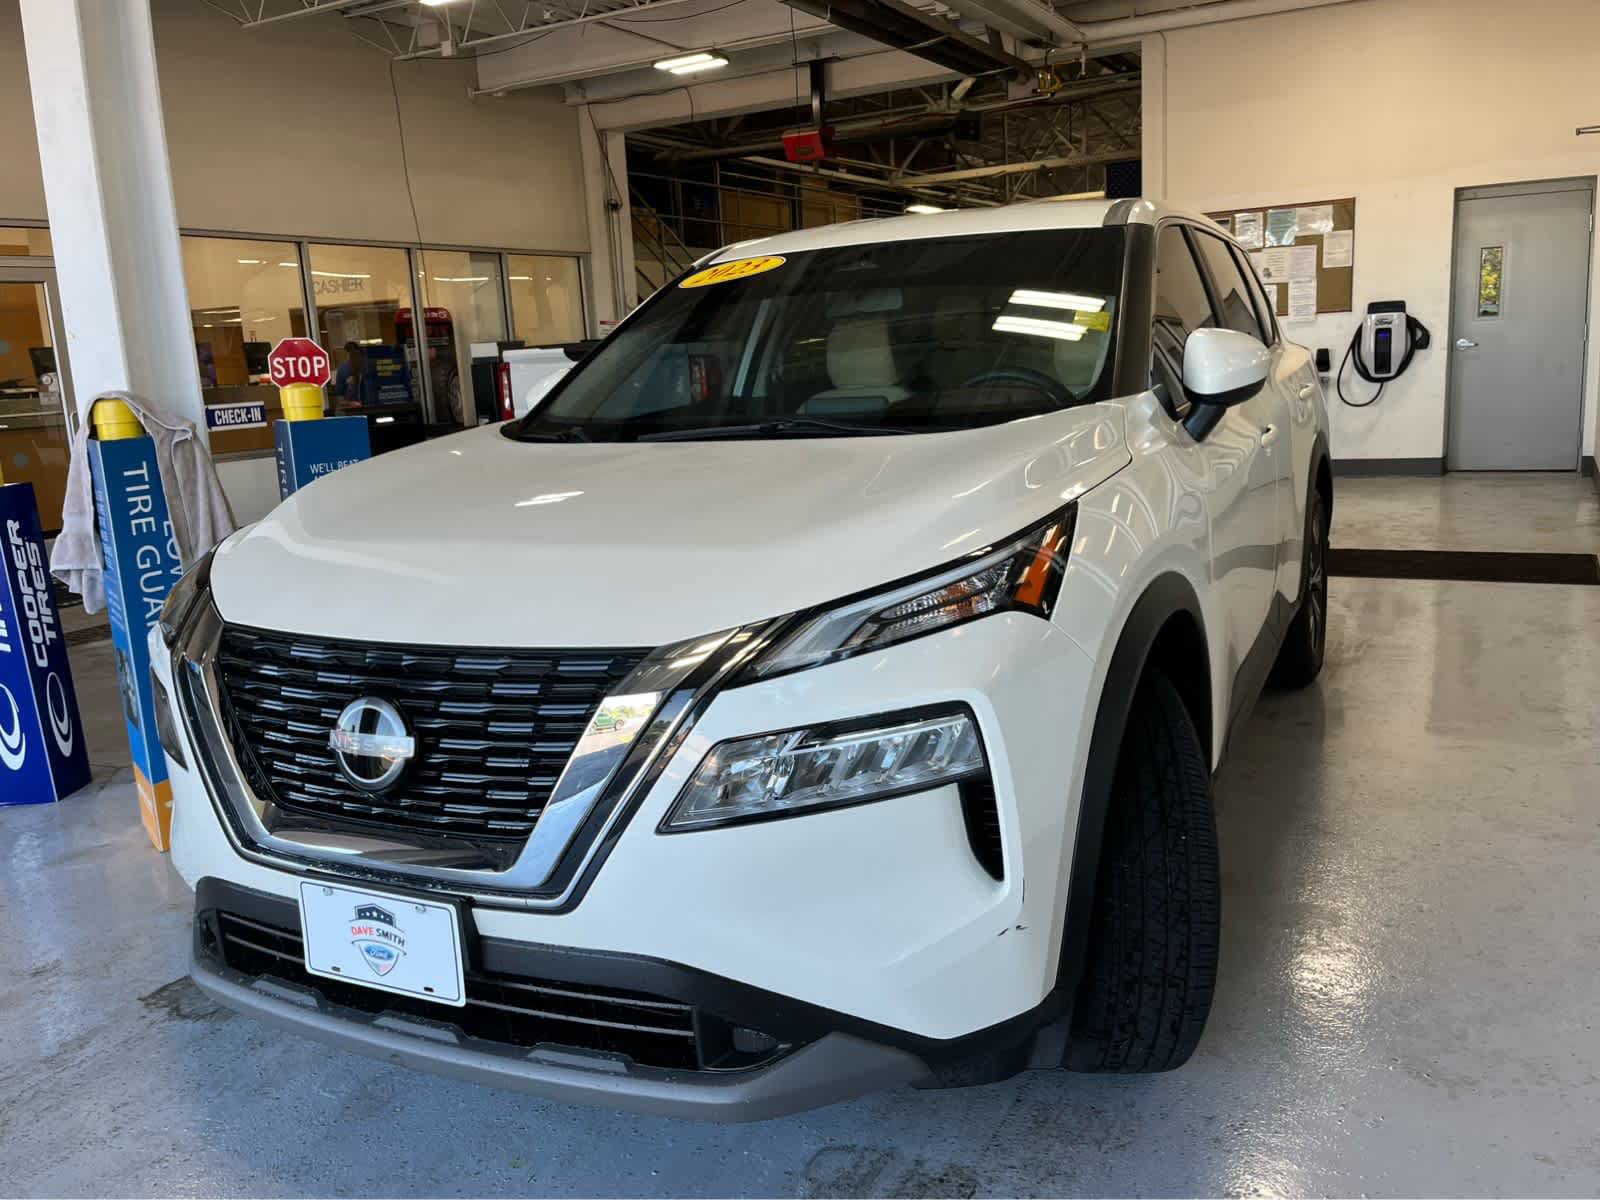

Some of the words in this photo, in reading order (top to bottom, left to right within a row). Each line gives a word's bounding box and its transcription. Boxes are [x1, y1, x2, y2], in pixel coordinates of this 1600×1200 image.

[313, 279, 366, 295] CASHIER
[272, 355, 326, 379] STOP
[214, 406, 262, 425] CHECK-IN
[310, 460, 335, 475] WE'LL
[122, 460, 157, 536] TIRE
[7, 519, 48, 668] COOPER
[26, 541, 57, 645] TIRES
[135, 544, 166, 629] GUA
[351, 926, 375, 937] DAVE
[375, 927, 406, 948] SMITH
